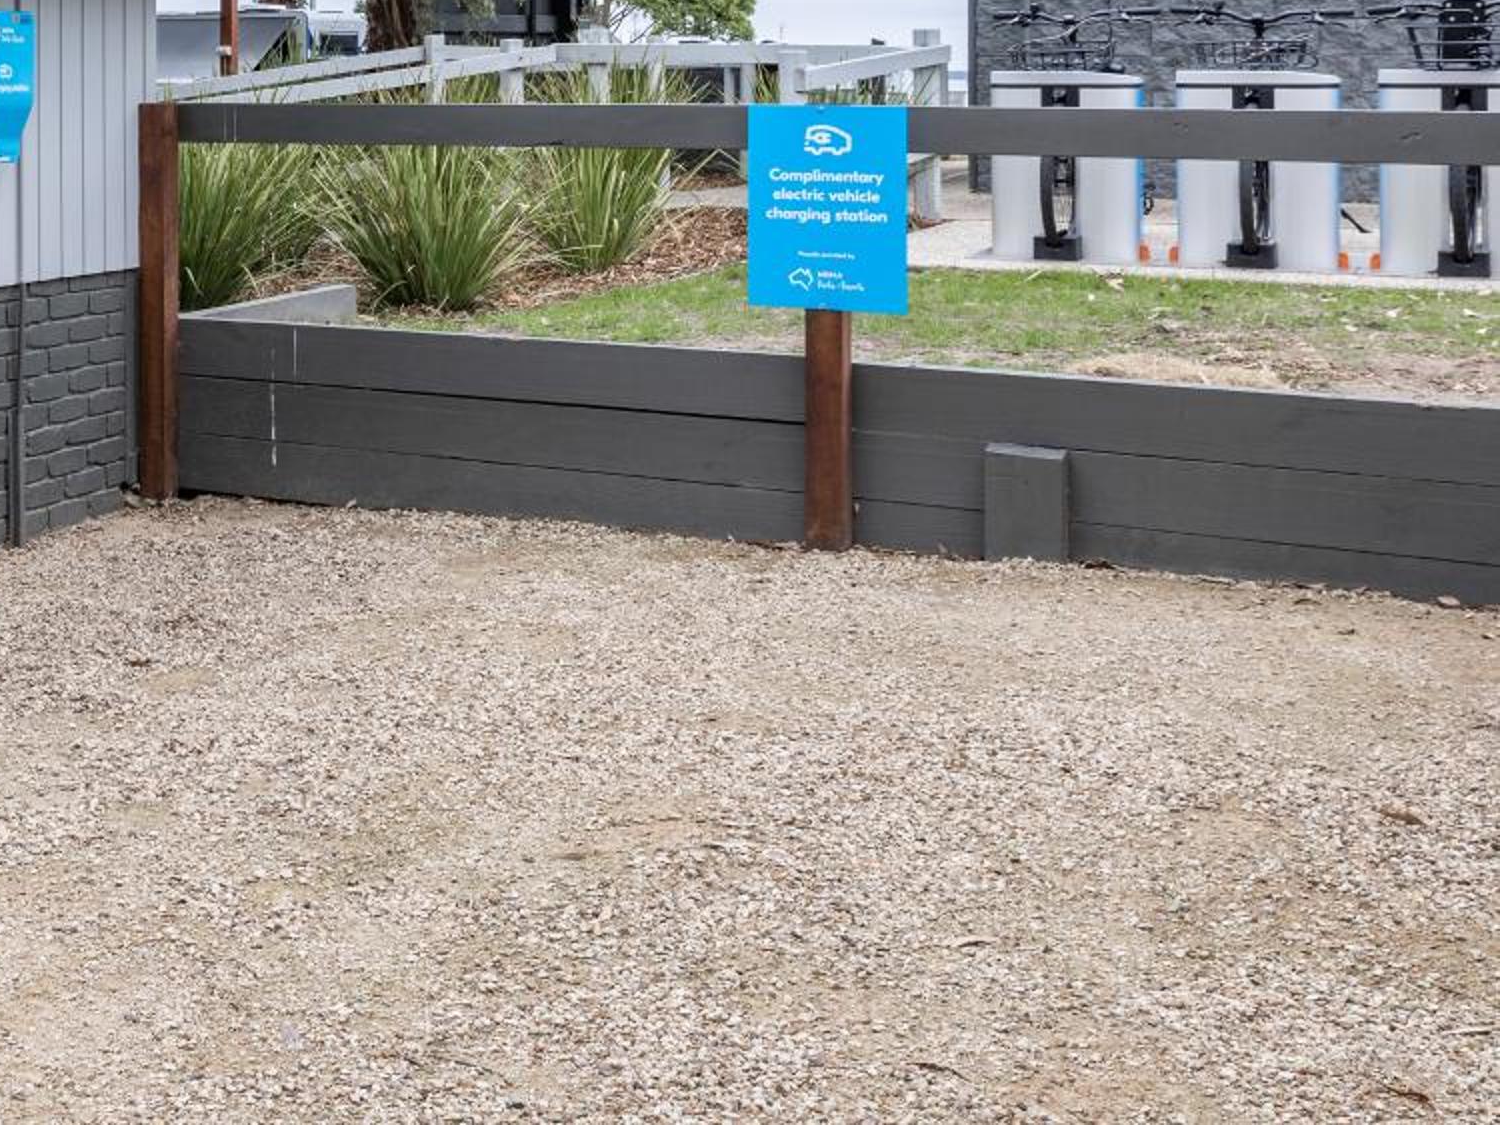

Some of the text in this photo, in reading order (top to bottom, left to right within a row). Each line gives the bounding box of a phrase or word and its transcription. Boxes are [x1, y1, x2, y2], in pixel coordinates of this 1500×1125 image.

[769, 168, 884, 185] Complimentary
[772, 187, 881, 203] electric vehicle
[765, 207, 888, 224] charging station
